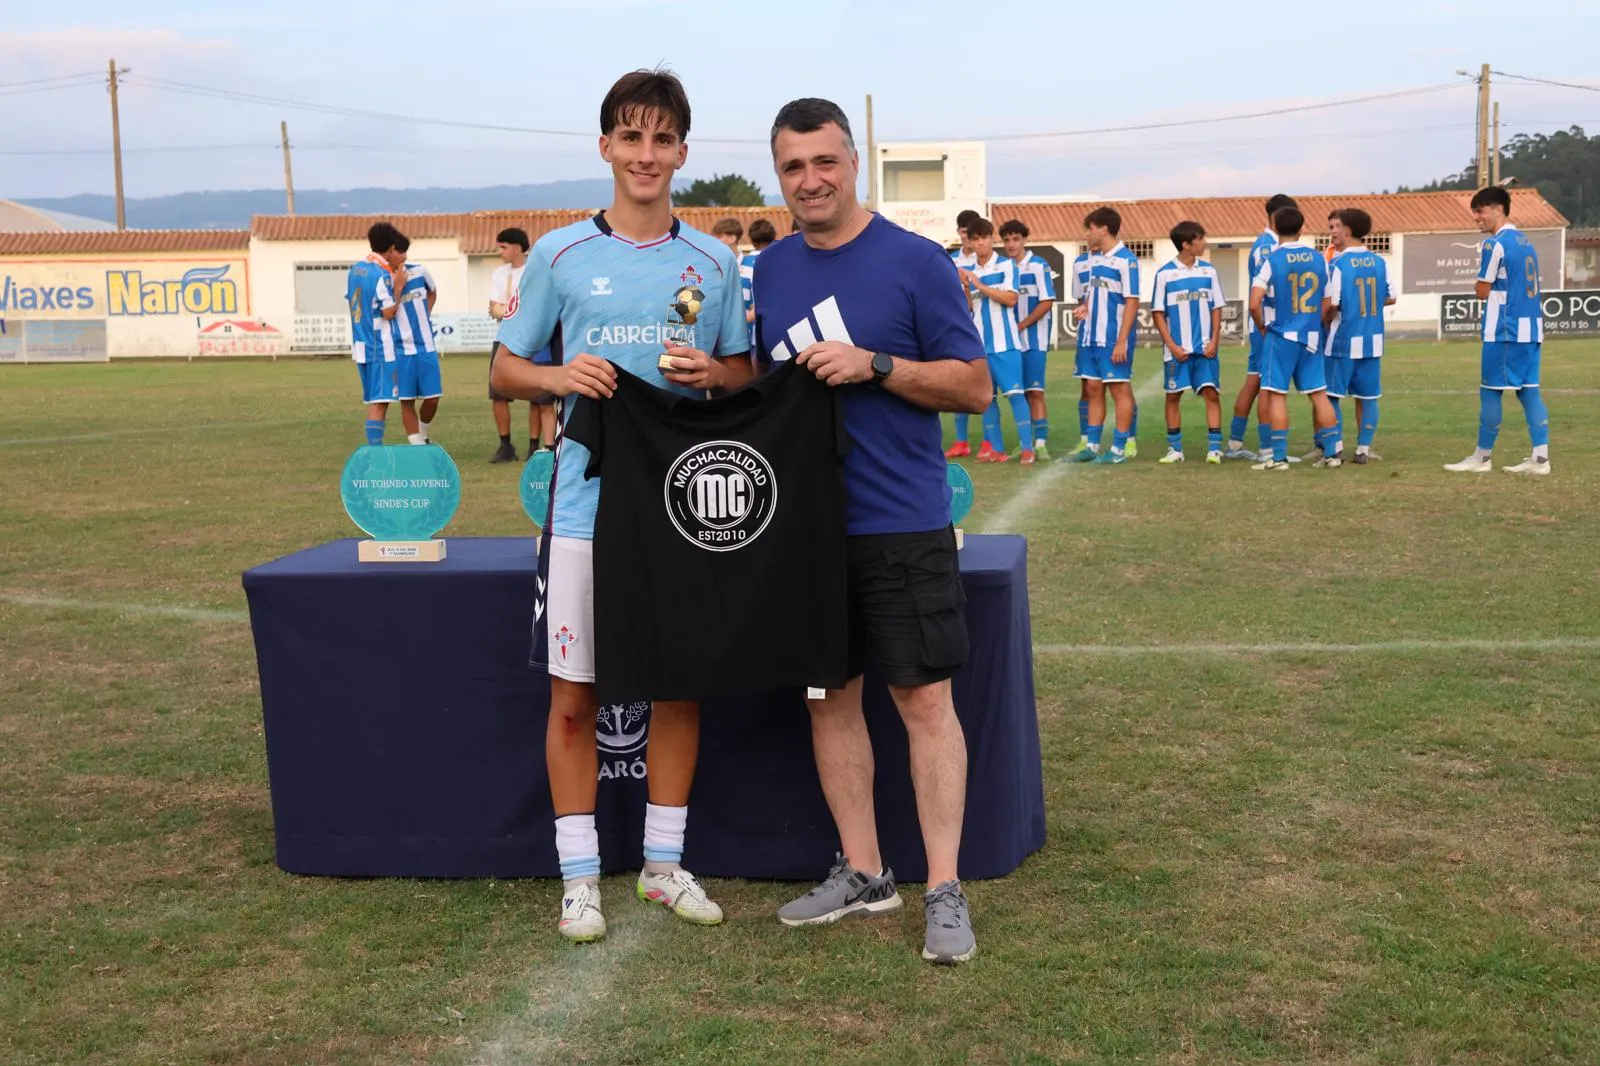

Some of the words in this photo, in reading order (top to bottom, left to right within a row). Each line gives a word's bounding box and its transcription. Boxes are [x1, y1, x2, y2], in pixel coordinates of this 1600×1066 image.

[1437, 259, 1470, 267] MANU
[1525, 256, 1538, 299] 9
[1288, 271, 1319, 314] 12
[1355, 276, 1377, 317] 11
[673, 449, 767, 488] MUCHACALIDAD
[352, 479, 368, 488] VIII
[371, 479, 408, 488] TORNEO
[410, 479, 450, 488] XUVENIL
[411, 498, 430, 508] CUP
[698, 529, 746, 541] EST2010
[598, 756, 648, 781] ARÓ
